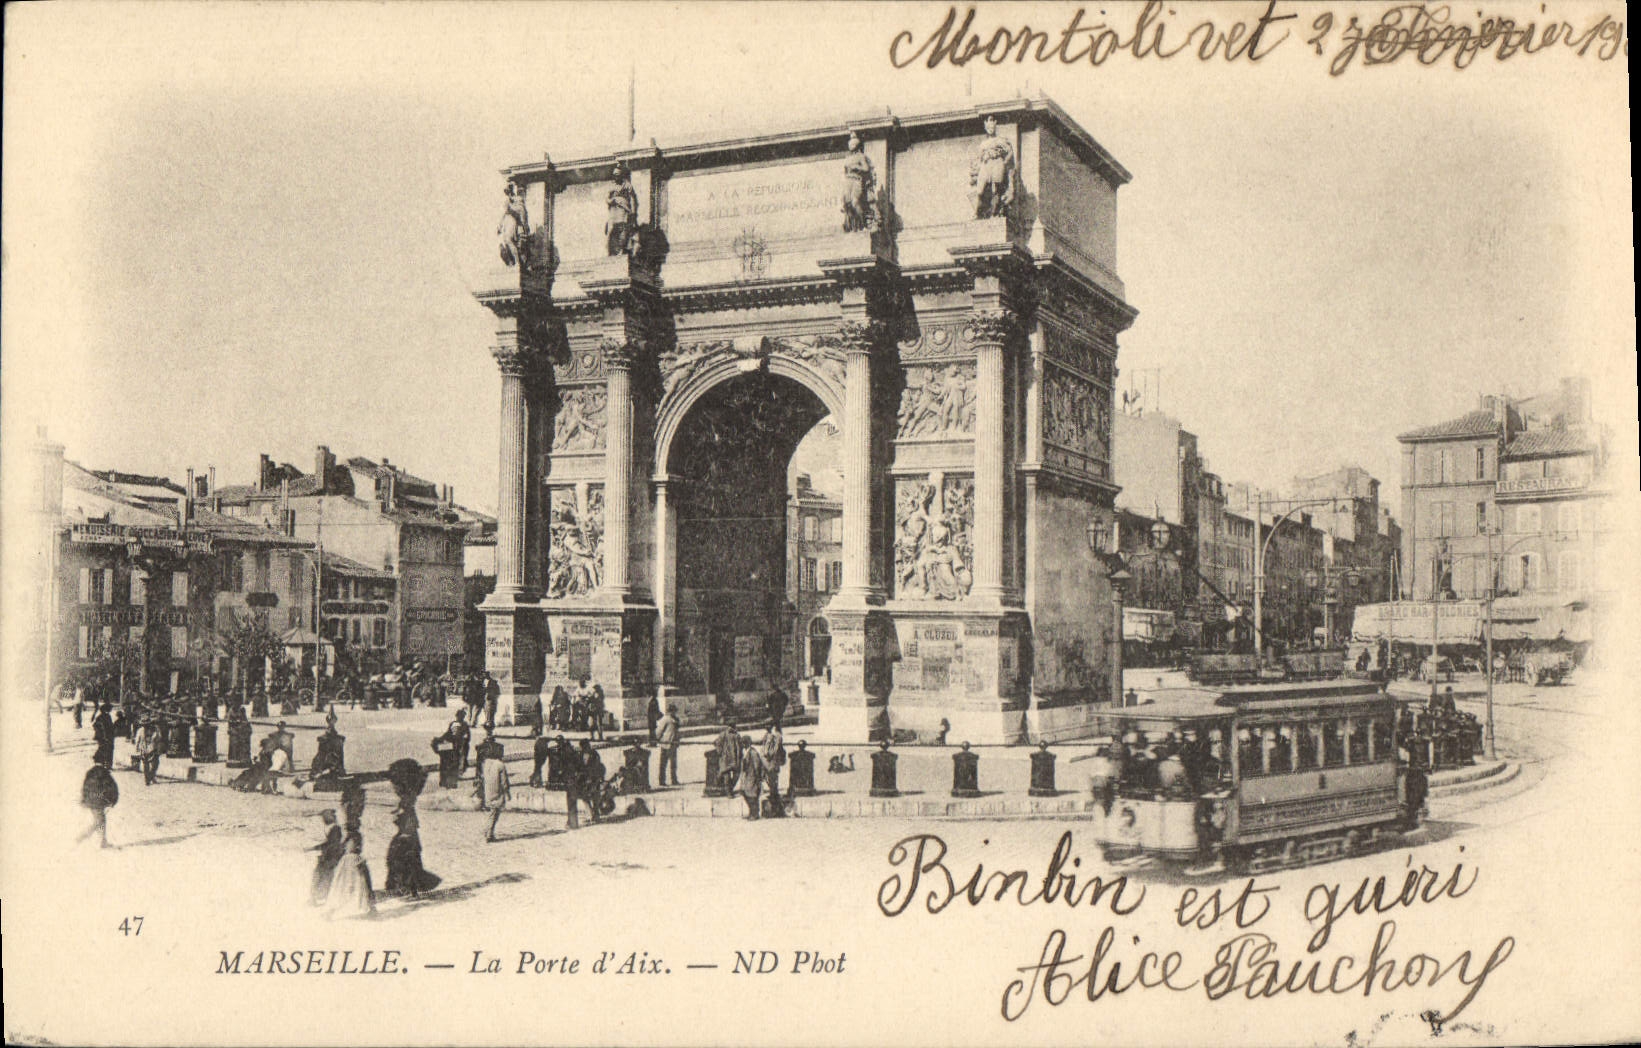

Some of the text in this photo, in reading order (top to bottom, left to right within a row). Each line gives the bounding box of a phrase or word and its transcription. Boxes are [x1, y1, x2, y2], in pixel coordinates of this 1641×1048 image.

[890, 4, 1296, 69] Montolivet
[1307, 12, 1334, 55] 2
[708, 191, 716, 201] A
[878, 831, 1479, 954] Binbin est guéri
[1001, 928, 1199, 1022] Alice
